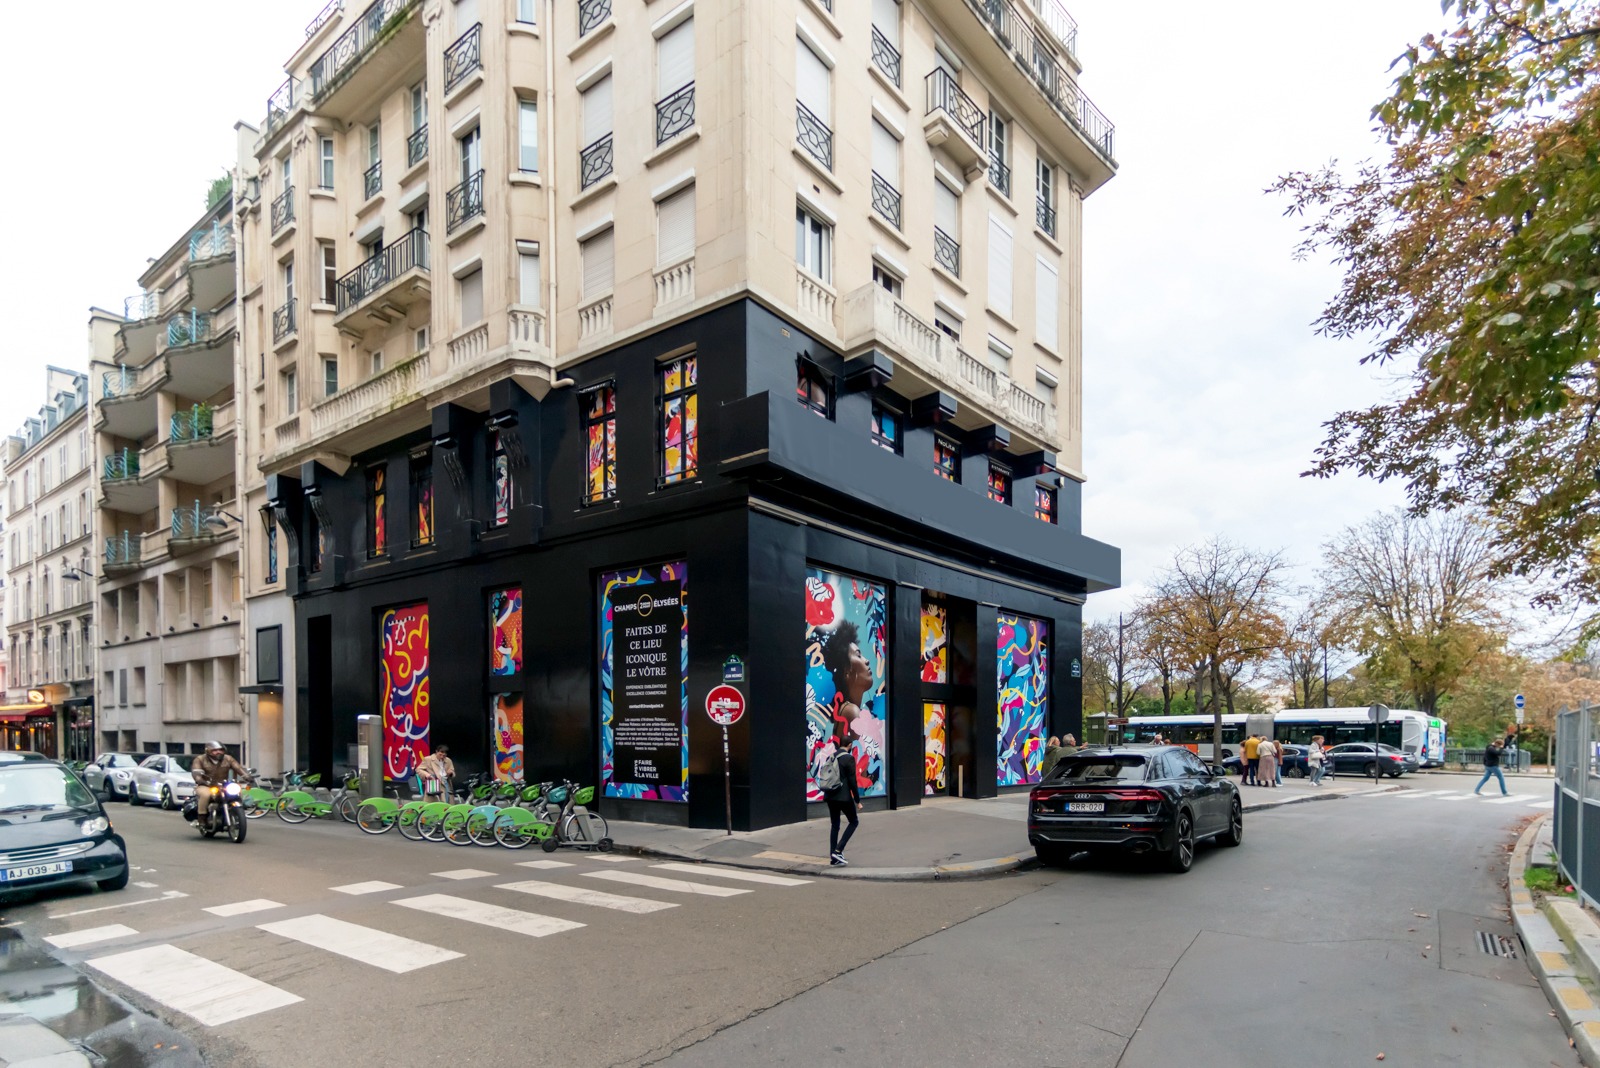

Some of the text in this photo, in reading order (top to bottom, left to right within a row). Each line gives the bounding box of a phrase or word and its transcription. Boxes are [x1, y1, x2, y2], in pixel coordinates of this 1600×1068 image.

[614, 603, 637, 612] CHAMPS
[653, 597, 679, 607] ÉLYSÉES
[625, 624, 667, 637] FAITES DE
[629, 639, 662, 650] CE LIEU
[625, 653, 667, 664] ICONIQUE
[626, 666, 667, 677] LE VÔTRE
